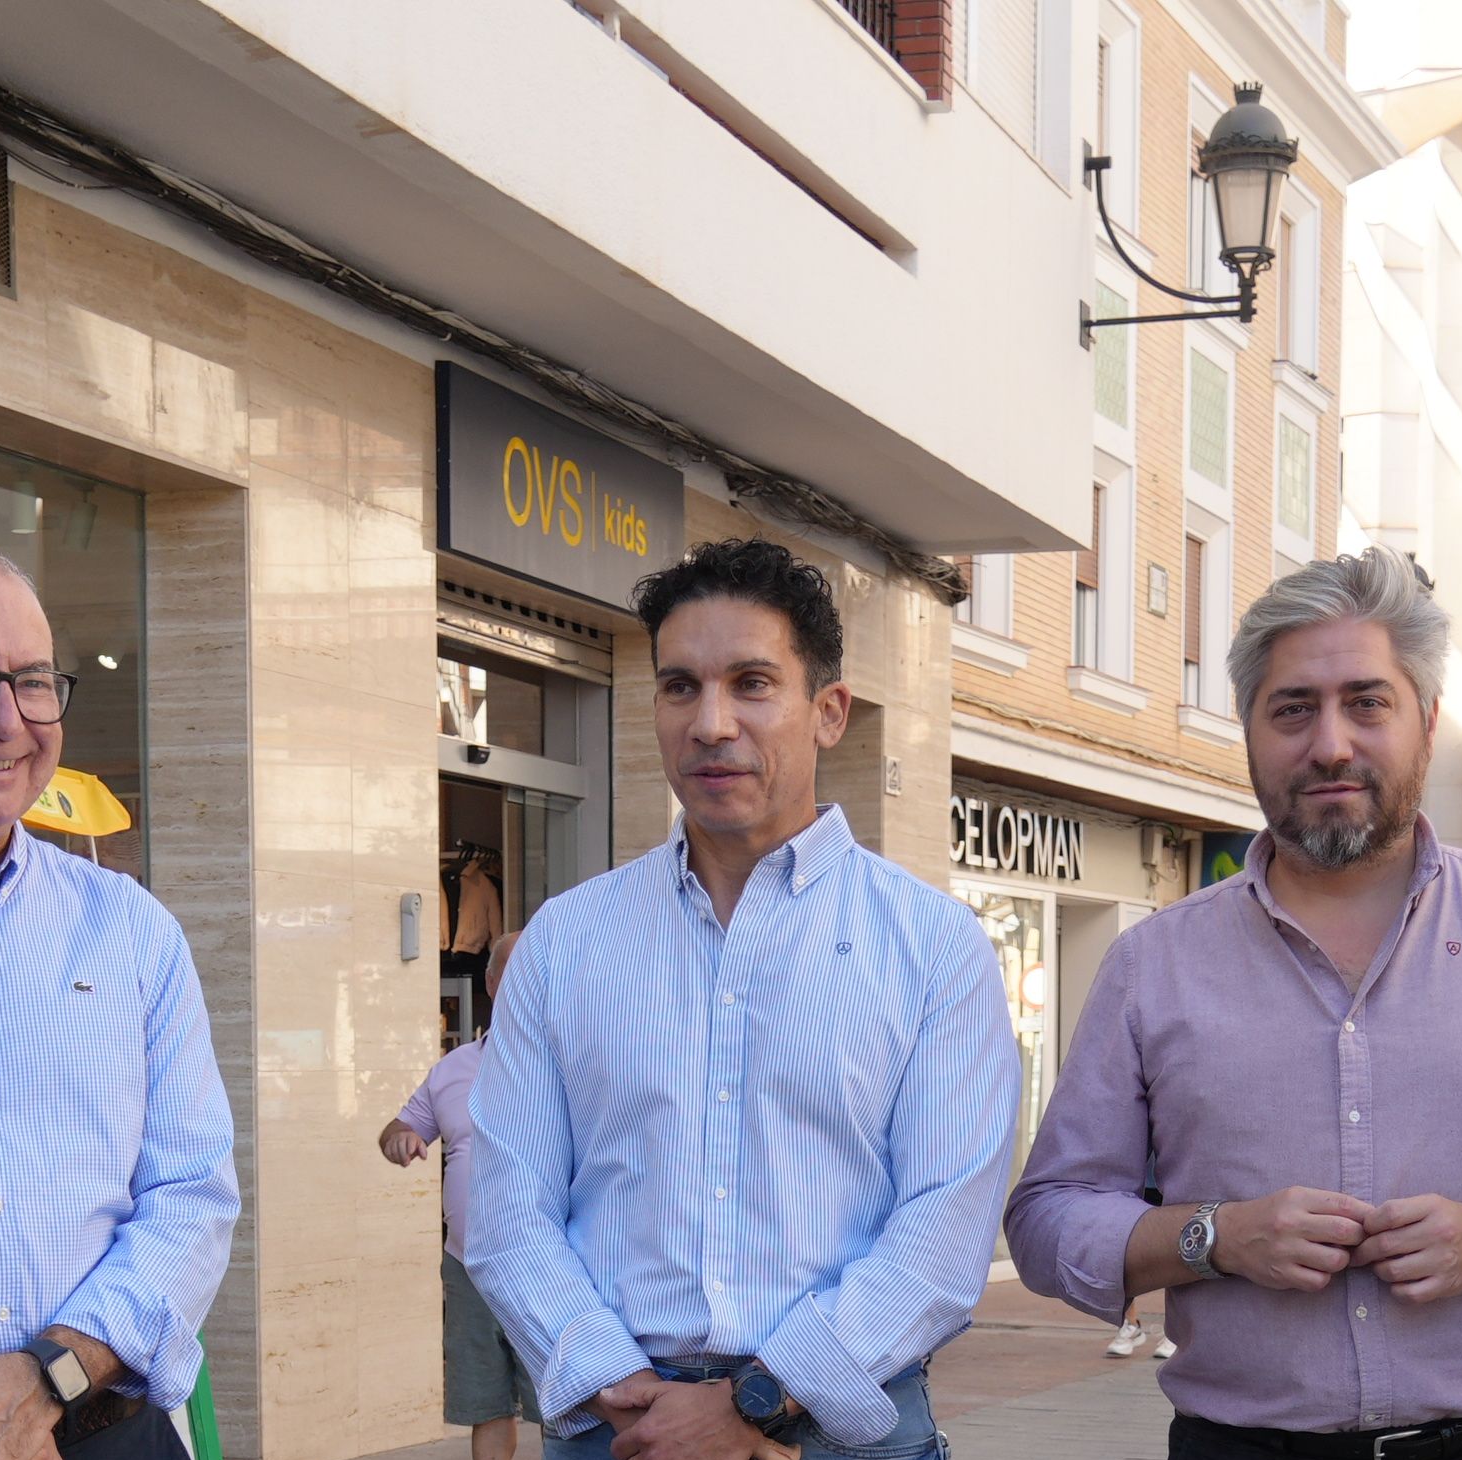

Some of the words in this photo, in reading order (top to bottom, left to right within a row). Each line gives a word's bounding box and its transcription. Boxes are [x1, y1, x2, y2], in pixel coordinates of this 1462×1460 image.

[503, 436, 584, 547] OVS
[604, 493, 648, 557] kids
[949, 795, 1084, 881] CELOPMAN
